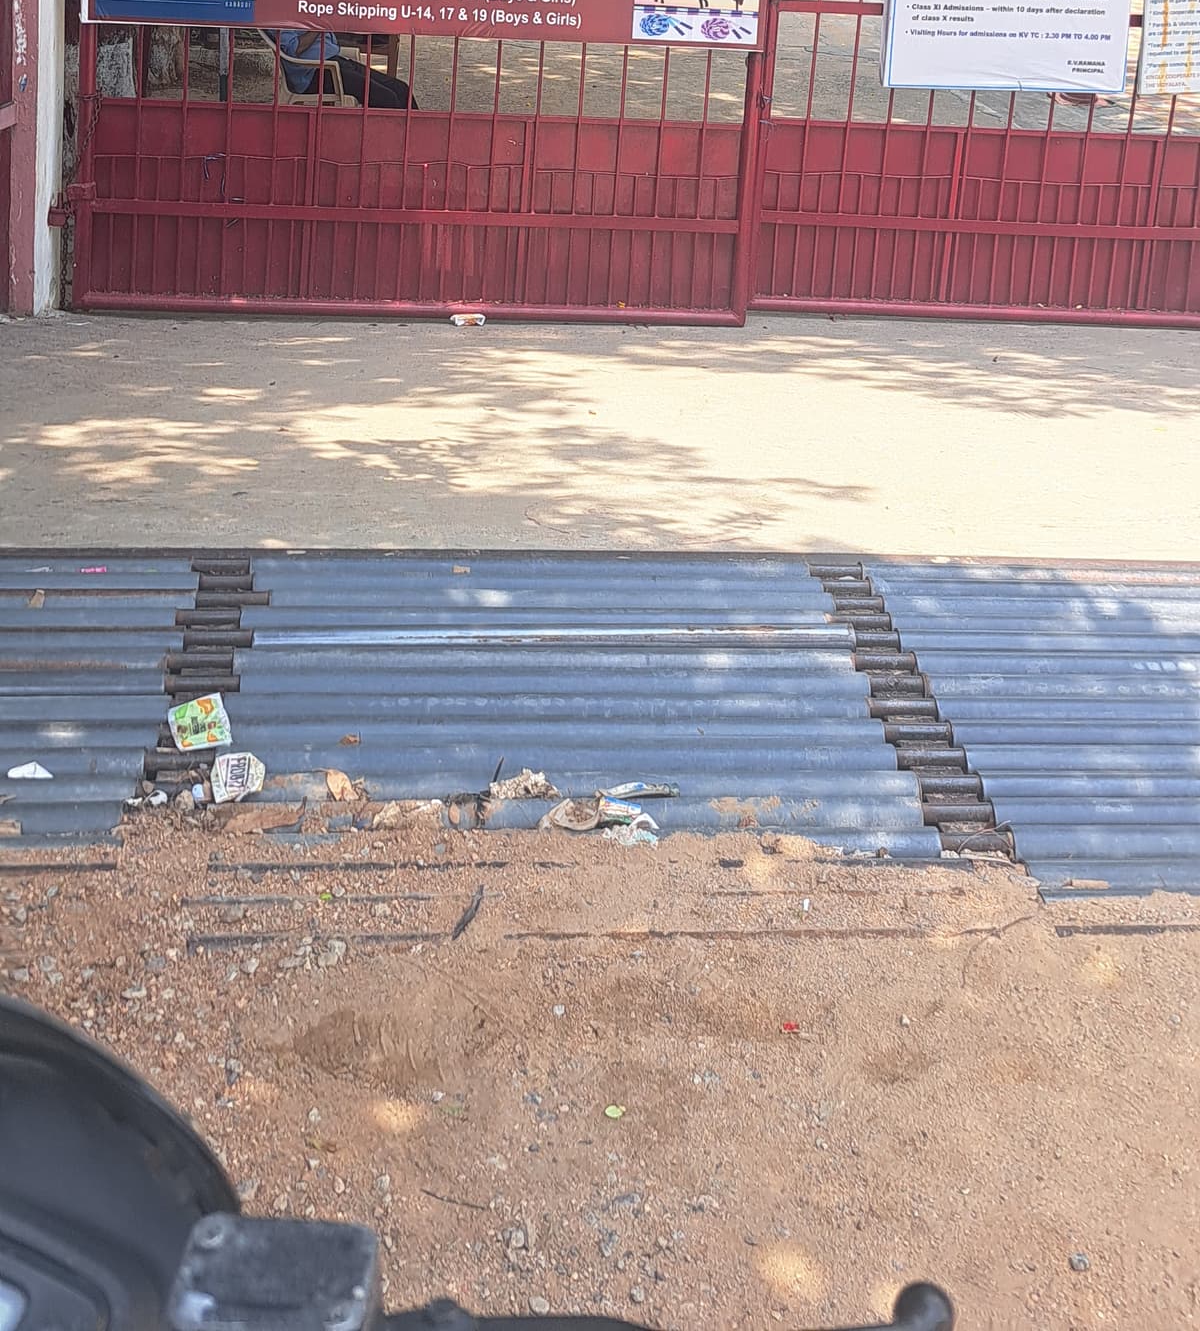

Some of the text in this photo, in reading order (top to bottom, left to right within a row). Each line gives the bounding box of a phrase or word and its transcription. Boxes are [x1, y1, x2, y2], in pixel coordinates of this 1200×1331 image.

[298, 0, 582, 28] Rope Skipping U-14, 17 & 19 (Boys & Girls)
[943, 4, 984, 12] Admissions
[1026, 7, 1044, 15] days
[1064, 8, 1106, 16] declaration
